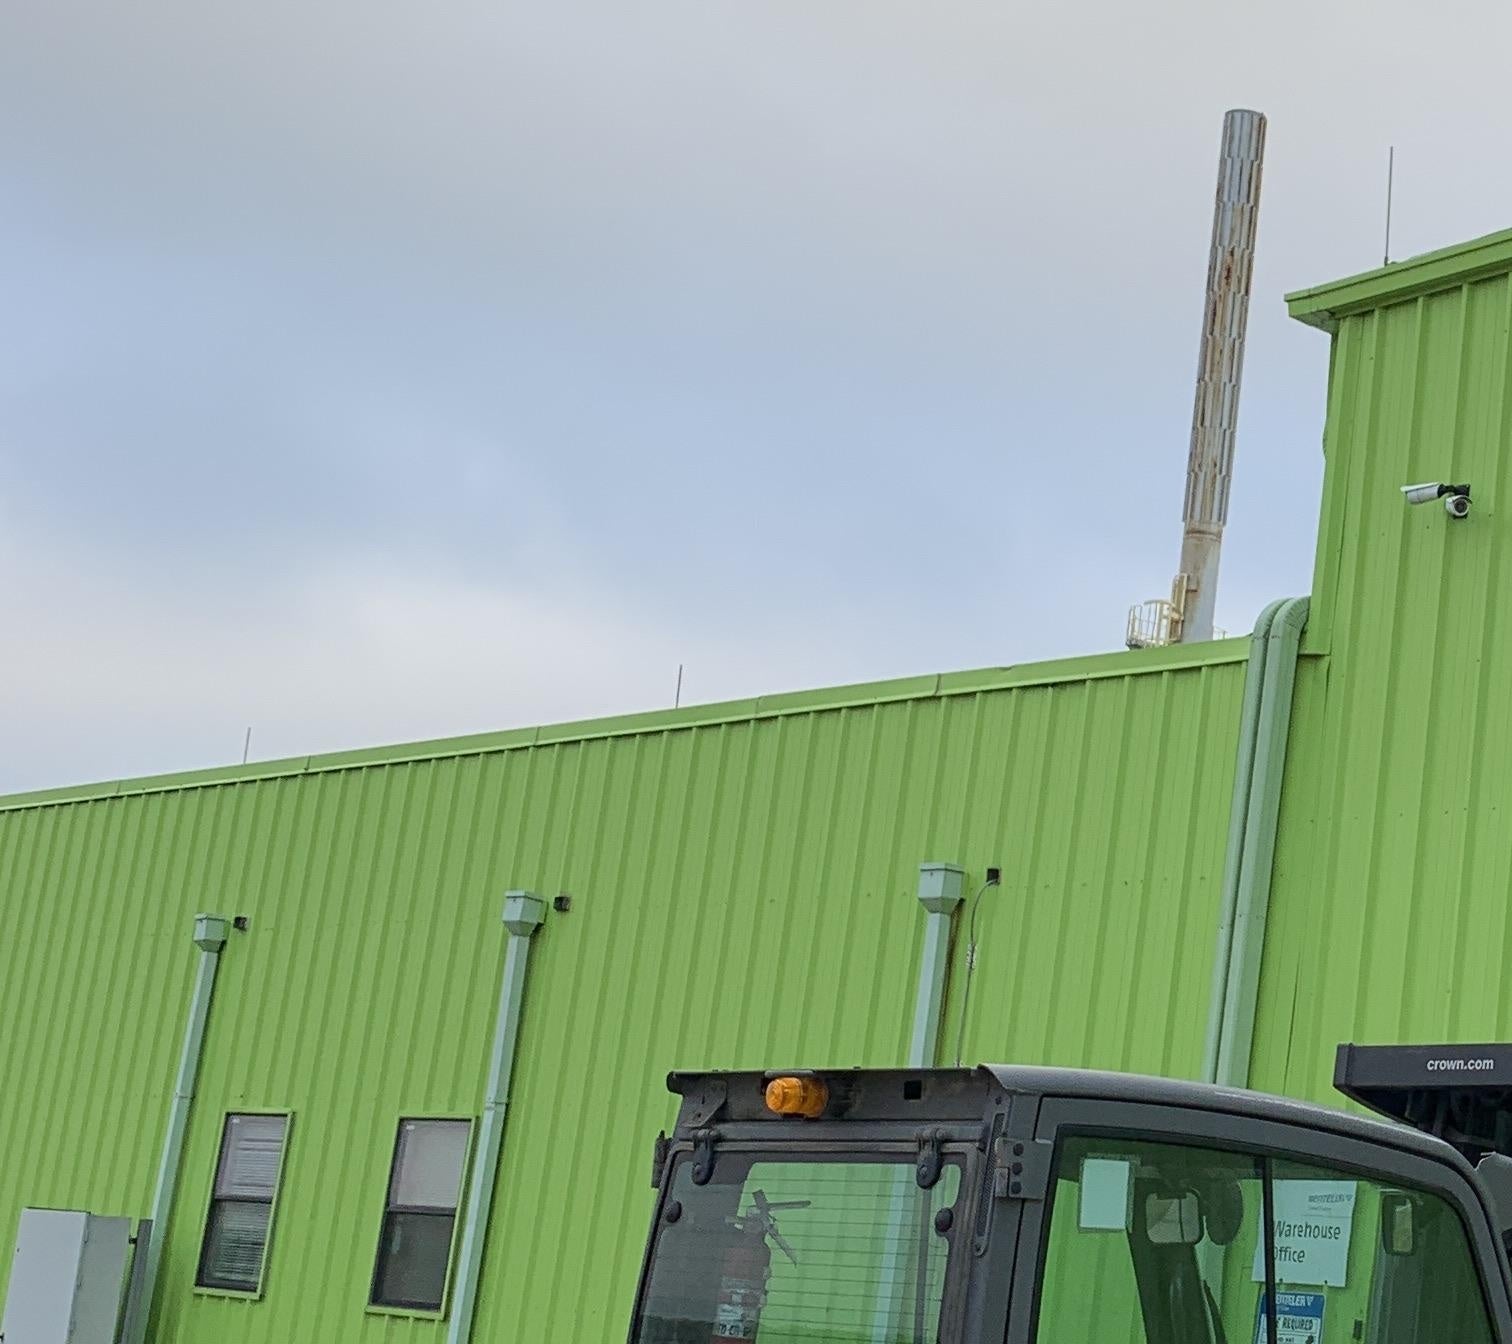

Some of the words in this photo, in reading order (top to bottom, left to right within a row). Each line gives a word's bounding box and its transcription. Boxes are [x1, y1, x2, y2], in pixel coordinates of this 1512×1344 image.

[1426, 1057, 1494, 1071] crown.com
[1274, 1220, 1341, 1240] Warehouse
[1274, 1246, 1305, 1263] ffice
